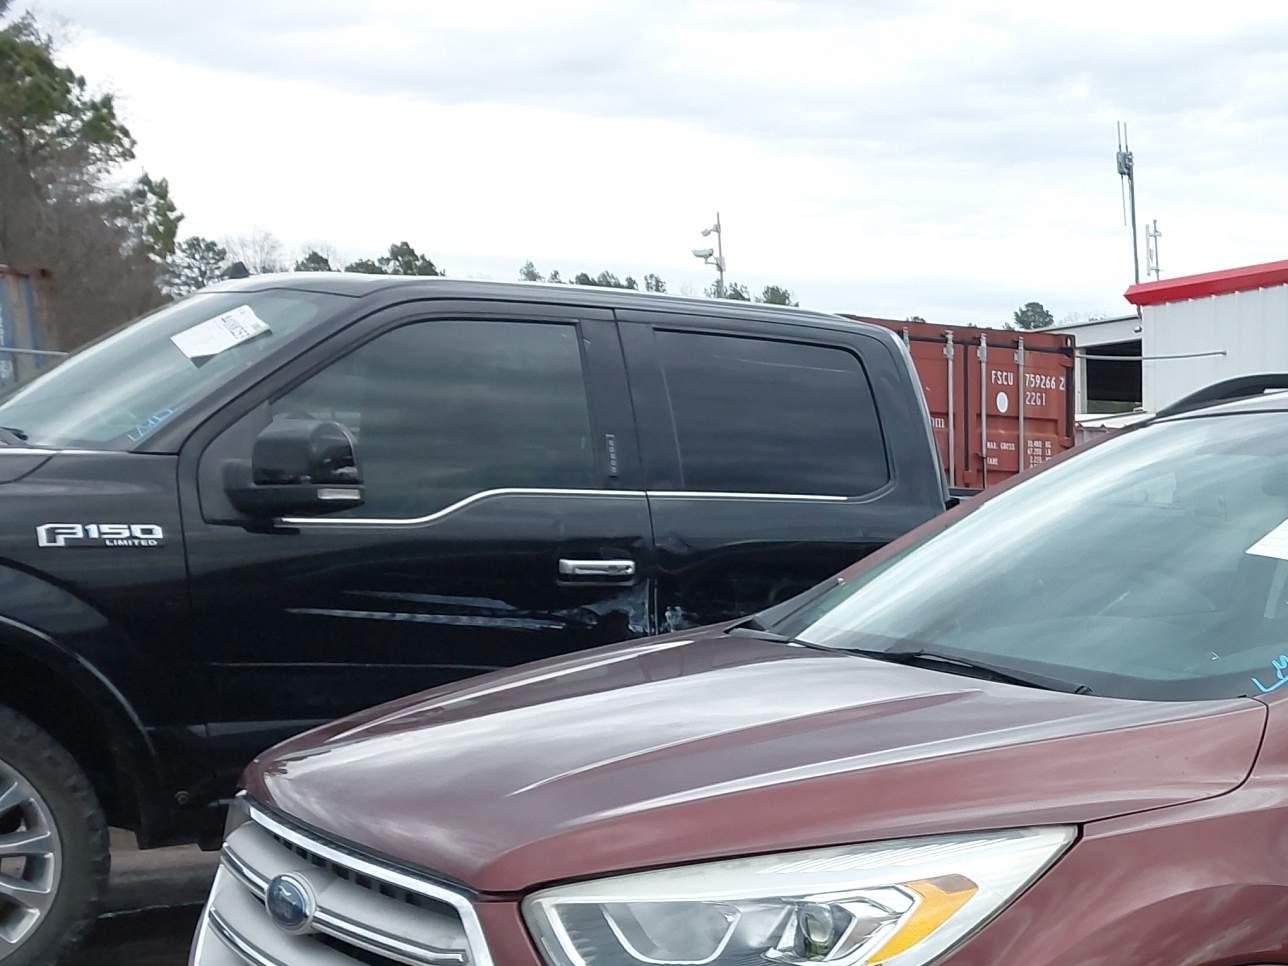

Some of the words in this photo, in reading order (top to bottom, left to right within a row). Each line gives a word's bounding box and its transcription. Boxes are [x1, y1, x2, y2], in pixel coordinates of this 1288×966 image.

[991, 370, 1014, 386] FSCU
[1024, 373, 1056, 390] 759266
[105, 539, 158, 547] LIMITED
